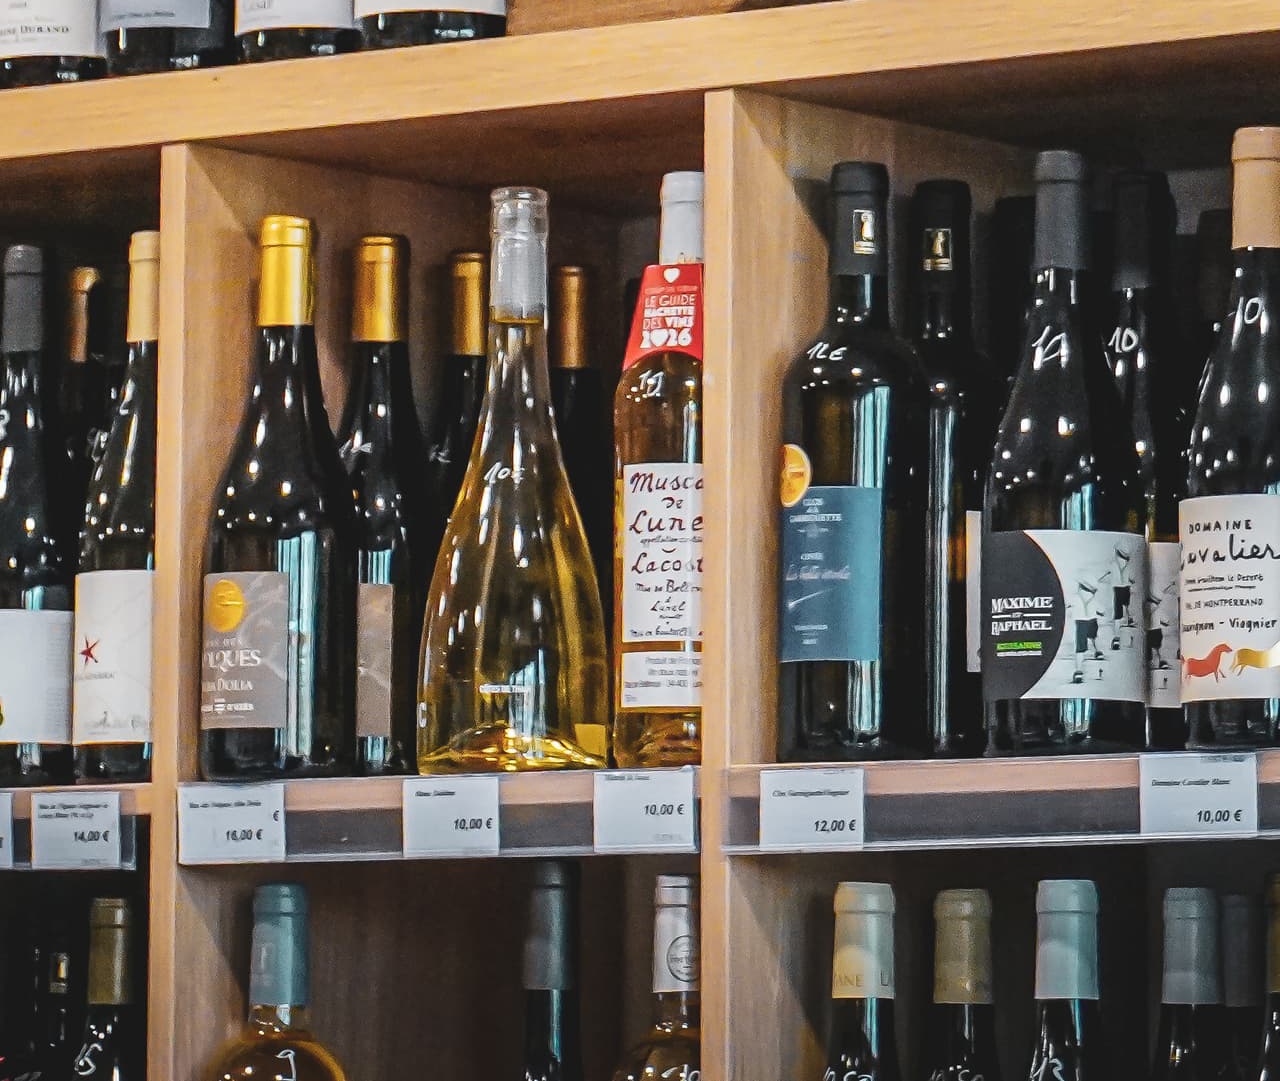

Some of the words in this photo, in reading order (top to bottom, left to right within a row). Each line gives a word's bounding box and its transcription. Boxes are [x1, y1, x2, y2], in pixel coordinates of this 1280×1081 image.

[645, 296, 657, 308] LE
[659, 294, 696, 306] GUIDE
[644, 306, 695, 318] HACHETTE
[643, 318, 663, 330] DES
[664, 316, 695, 328] VINS
[1188, 519, 1252, 535] DOMAINE
[991, 596, 1054, 614] MAXIME
[1229, 616, 1278, 633] Viognier
[644, 804, 674, 817] 10,00
[677, 803, 685, 815] €
[1197, 809, 1230, 824] 10,00
[1234, 809, 1243, 822] €
[453, 818, 483, 830] 10,00
[486, 818, 493, 830] €
[814, 819, 845, 833] 12,00
[848, 819, 857, 831] €
[256, 829, 264, 841] €
